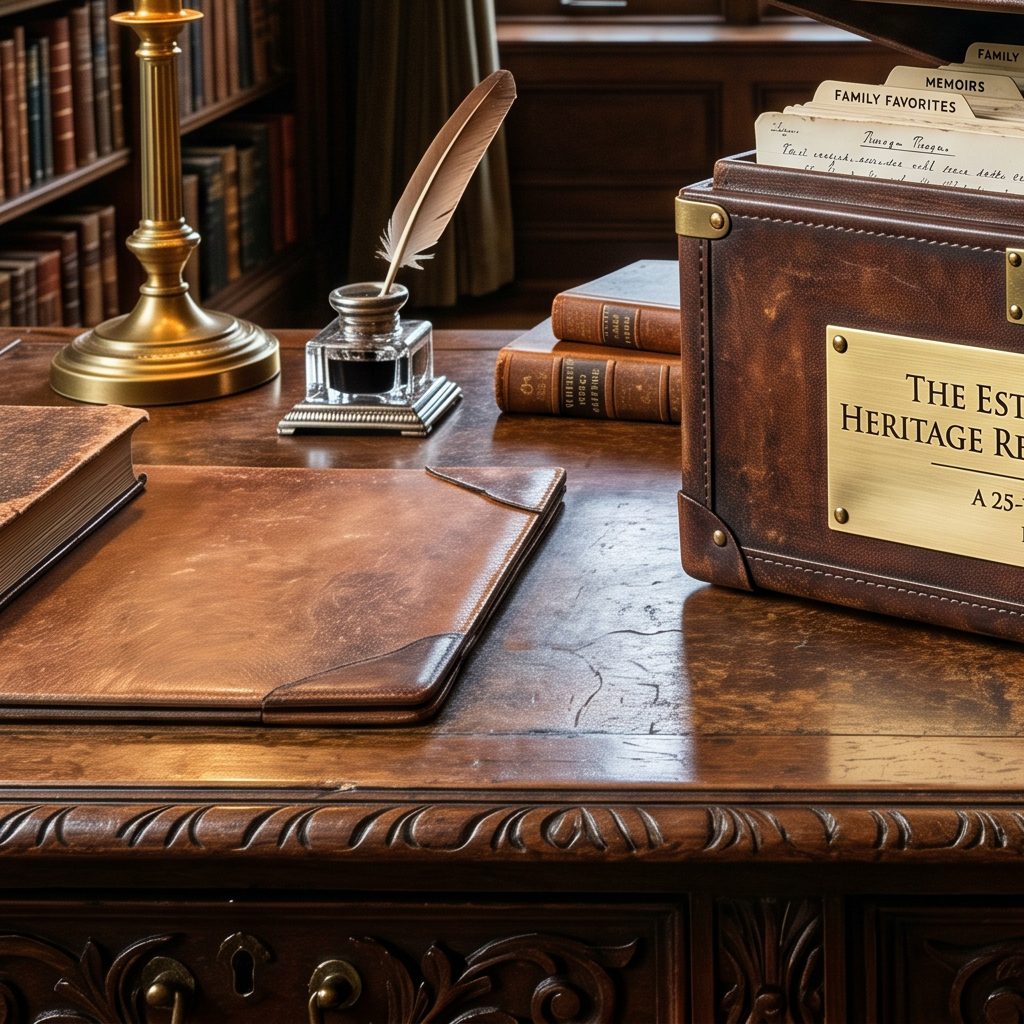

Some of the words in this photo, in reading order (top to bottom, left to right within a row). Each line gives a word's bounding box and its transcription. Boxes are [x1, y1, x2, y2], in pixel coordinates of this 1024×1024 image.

[977, 48, 1020, 63] FAMILY
[925, 76, 985, 93] MEMOIRS
[835, 89, 881, 105] FAMILY
[885, 94, 956, 114] FAVORITES
[905, 373, 966, 410] THE
[840, 402, 983, 454] HERITAGE
[971, 488, 987, 508] A
